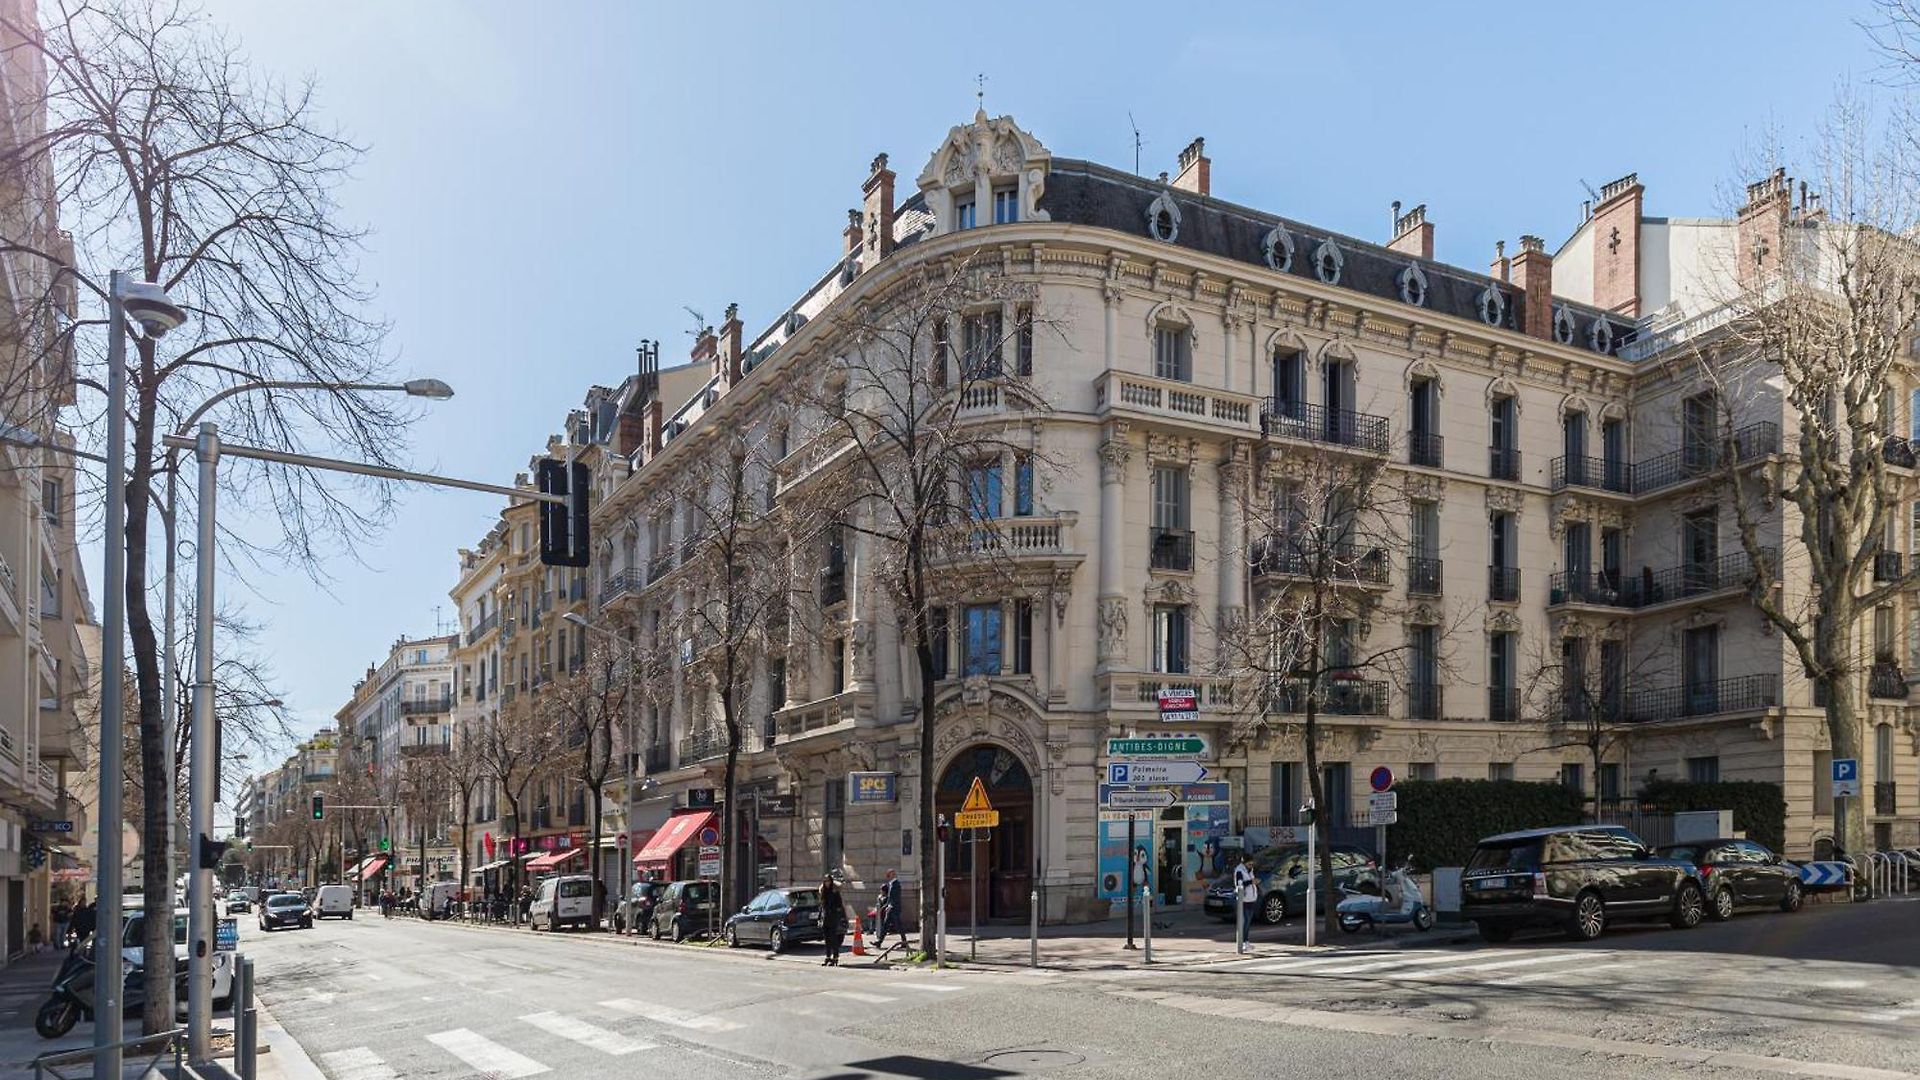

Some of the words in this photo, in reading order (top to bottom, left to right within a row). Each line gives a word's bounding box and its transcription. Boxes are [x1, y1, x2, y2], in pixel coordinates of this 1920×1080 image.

[1112, 742, 1187, 752] ANTIBES-DIGNE
[1115, 767, 1126, 781] P
[1839, 763, 1850, 778] P
[860, 778, 887, 790] SPCS
[1270, 828, 1294, 839] SPCS
[406, 855, 455, 864] PHAMACIE
